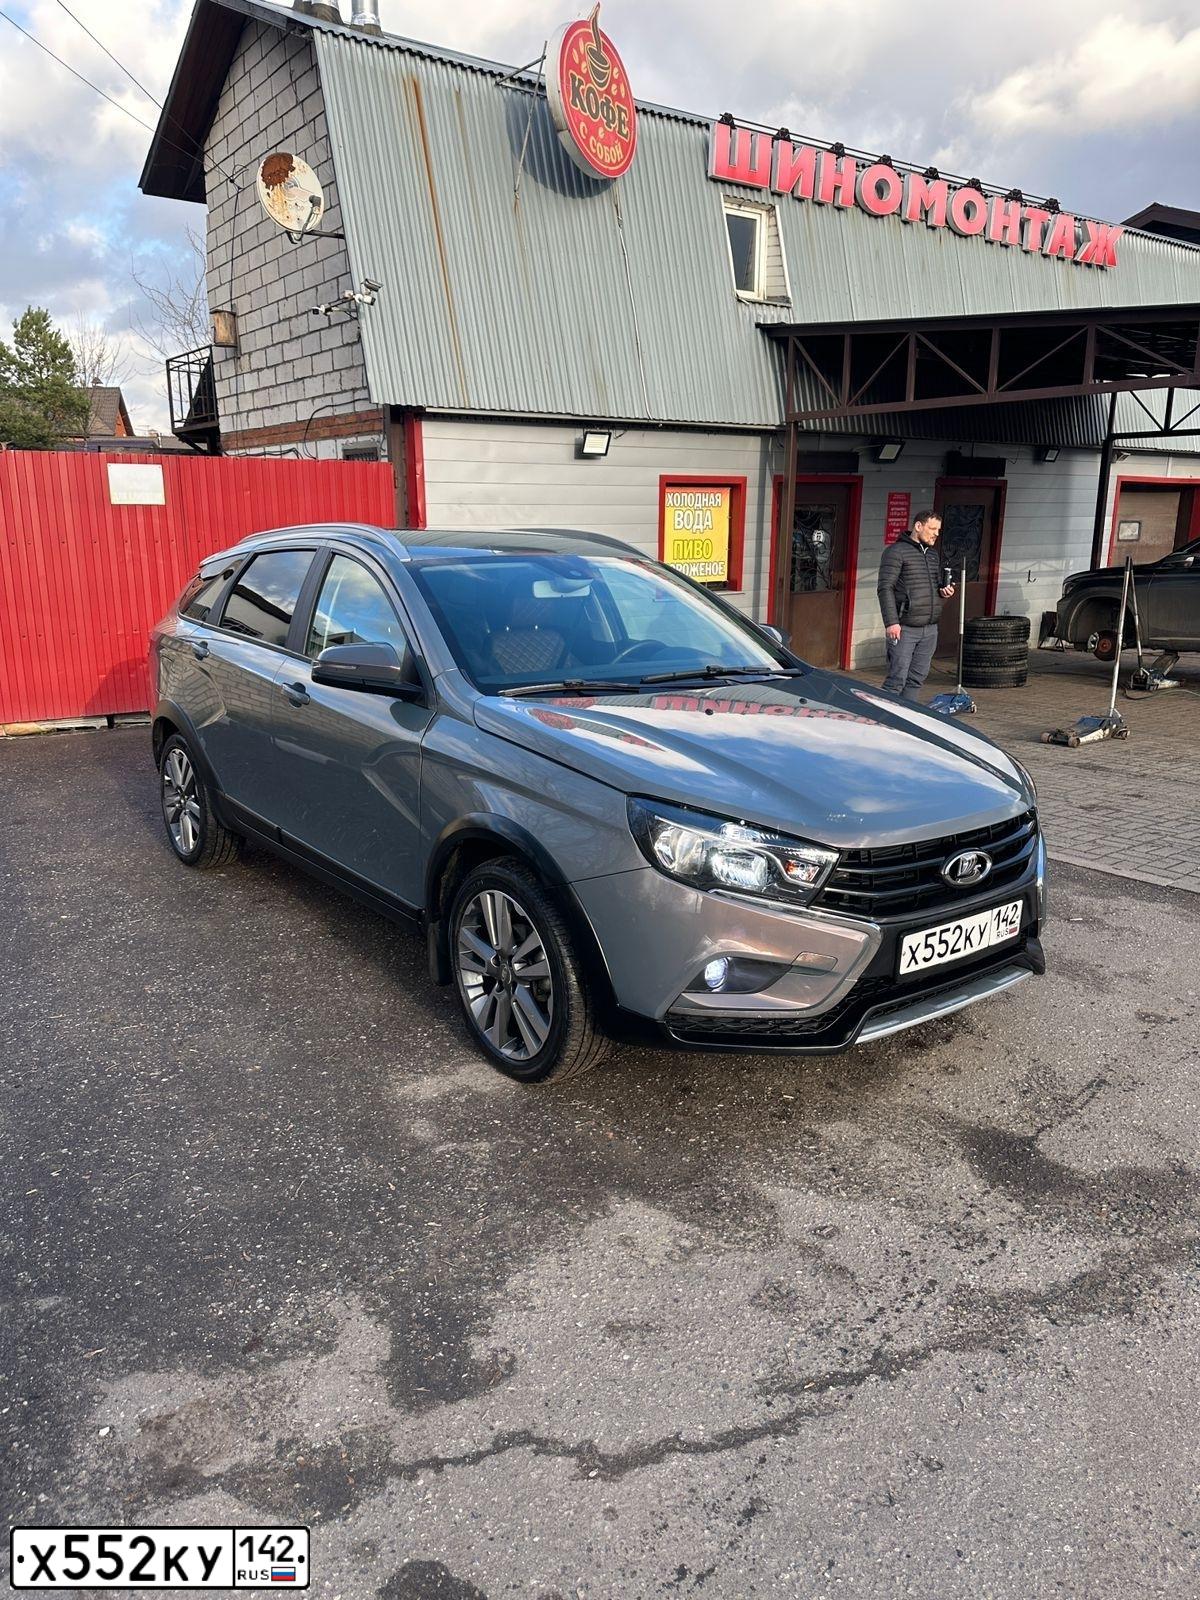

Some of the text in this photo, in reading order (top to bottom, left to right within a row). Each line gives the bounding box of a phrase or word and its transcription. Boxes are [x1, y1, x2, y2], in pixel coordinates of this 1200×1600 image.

[569, 70, 630, 142] КОФЕ
[579, 121, 624, 164] С СОБОЙ
[708, 122, 1123, 268] ШИНОМОНТАЖ
[666, 492, 722, 509] ХОЛОДНАЯ
[673, 509, 714, 534] ВОДА
[673, 539, 714, 560] ПИВО
[906, 903, 1019, 969] Х552КУ 142
[996, 927, 1009, 939] RUS
